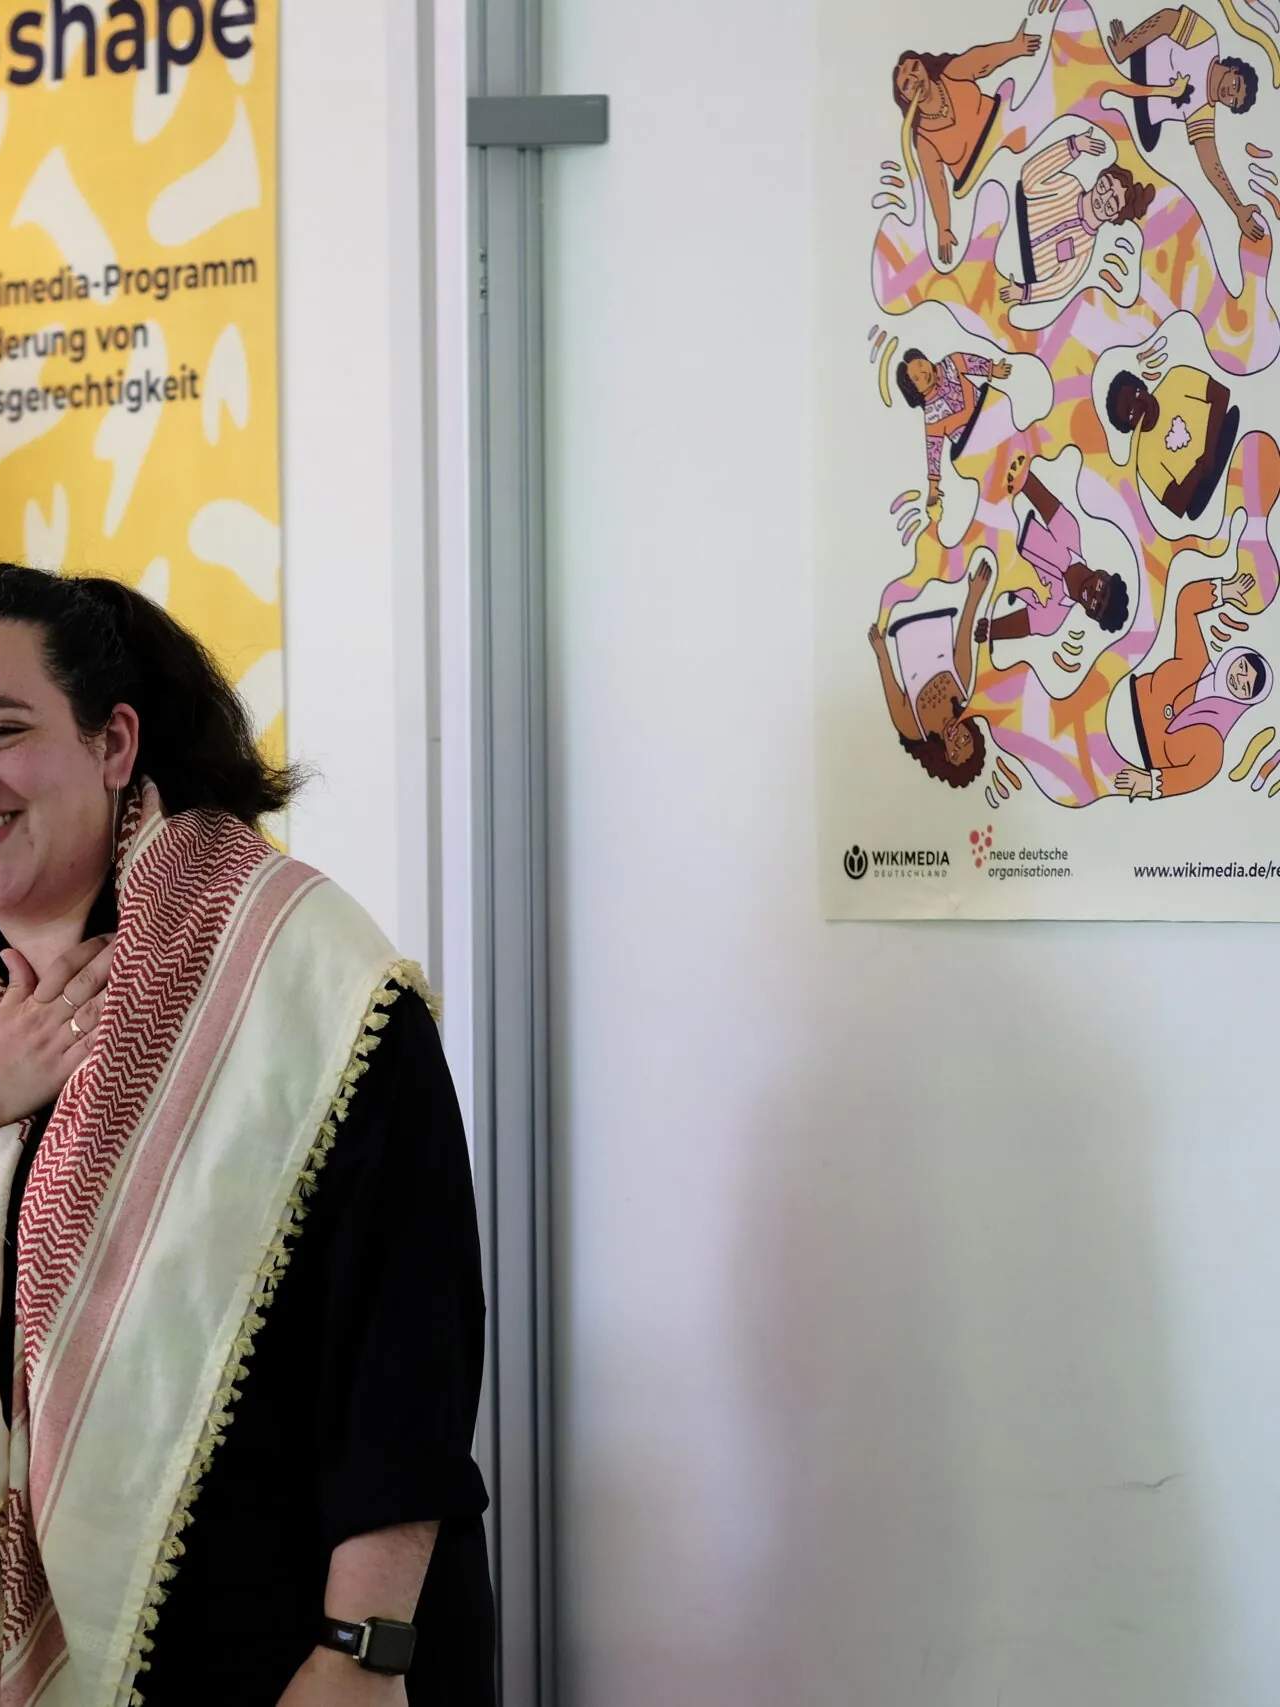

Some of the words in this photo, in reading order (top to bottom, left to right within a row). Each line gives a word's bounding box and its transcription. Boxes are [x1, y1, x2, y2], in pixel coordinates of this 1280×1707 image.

[96, 321, 148, 351] von
[871, 850, 950, 866] WIKIMEDIA
[989, 850, 1016, 861] neue
[1018, 847, 1068, 861] deutsche
[874, 869, 948, 878] DEUTSCHLAND
